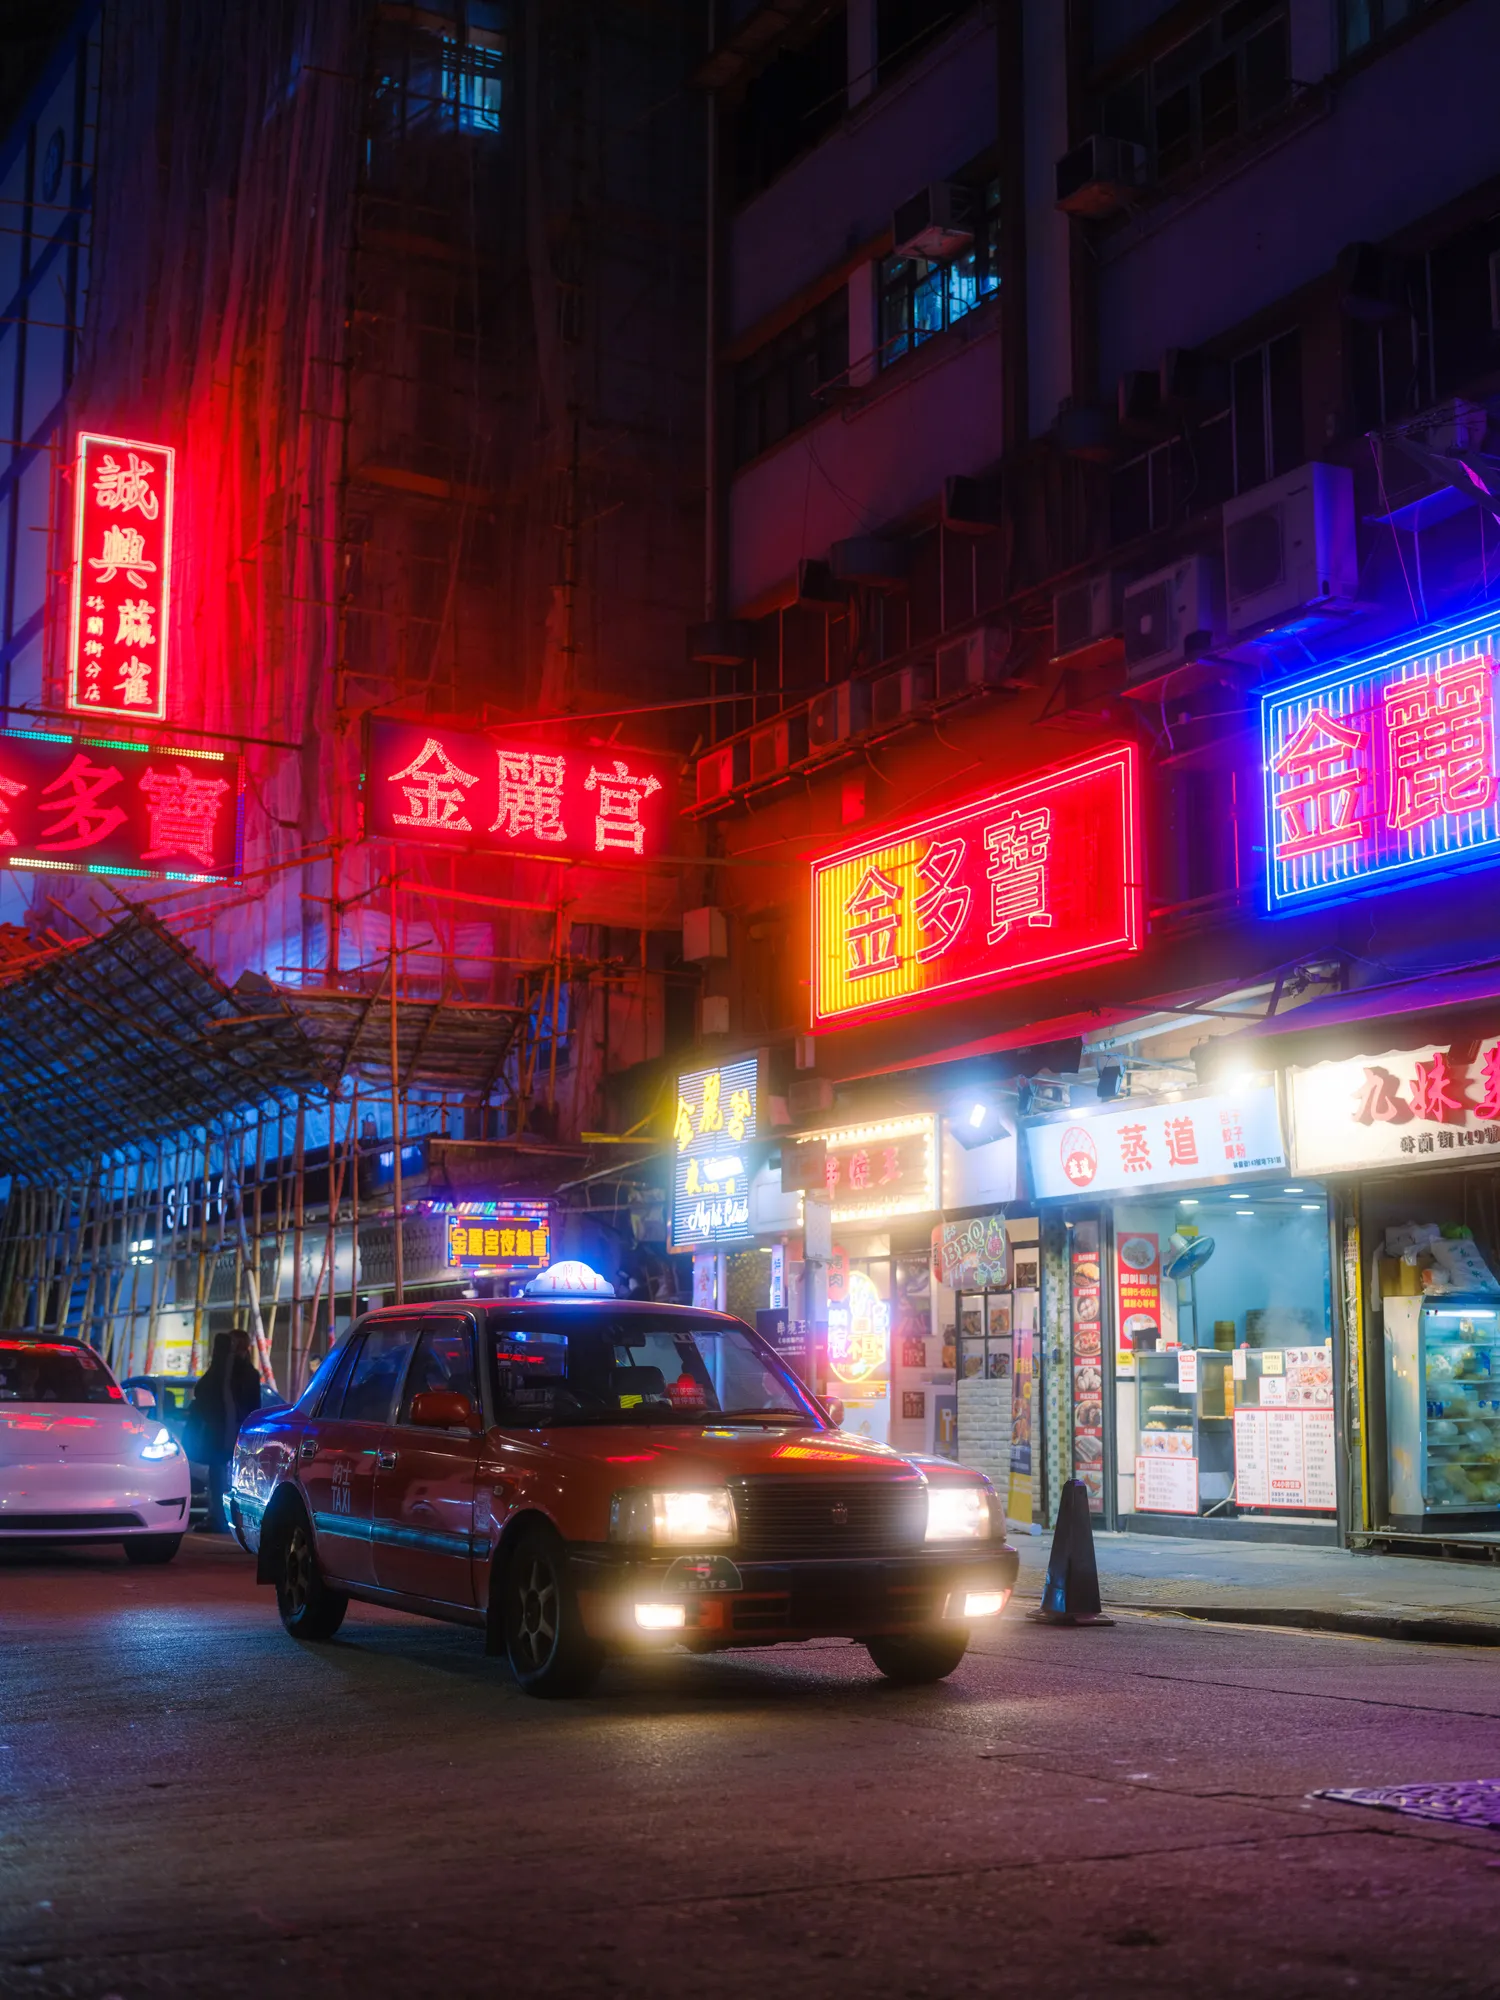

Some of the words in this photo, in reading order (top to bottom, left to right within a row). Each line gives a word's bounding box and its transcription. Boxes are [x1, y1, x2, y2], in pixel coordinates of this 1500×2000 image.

[842, 806, 1053, 983] 金多寶
[1117, 1116, 1199, 1174] 蒸道
[687, 1201, 723, 1236] Night
[723, 1198, 749, 1228] Club
[941, 1219, 985, 1268] BBQ
[549, 1276, 599, 1291] TAXI
[332, 1459, 352, 1486] 的士
[331, 1485, 352, 1514] TAXI
[678, 1580, 727, 1591] SEATS
[695, 1562, 712, 1580] 5
